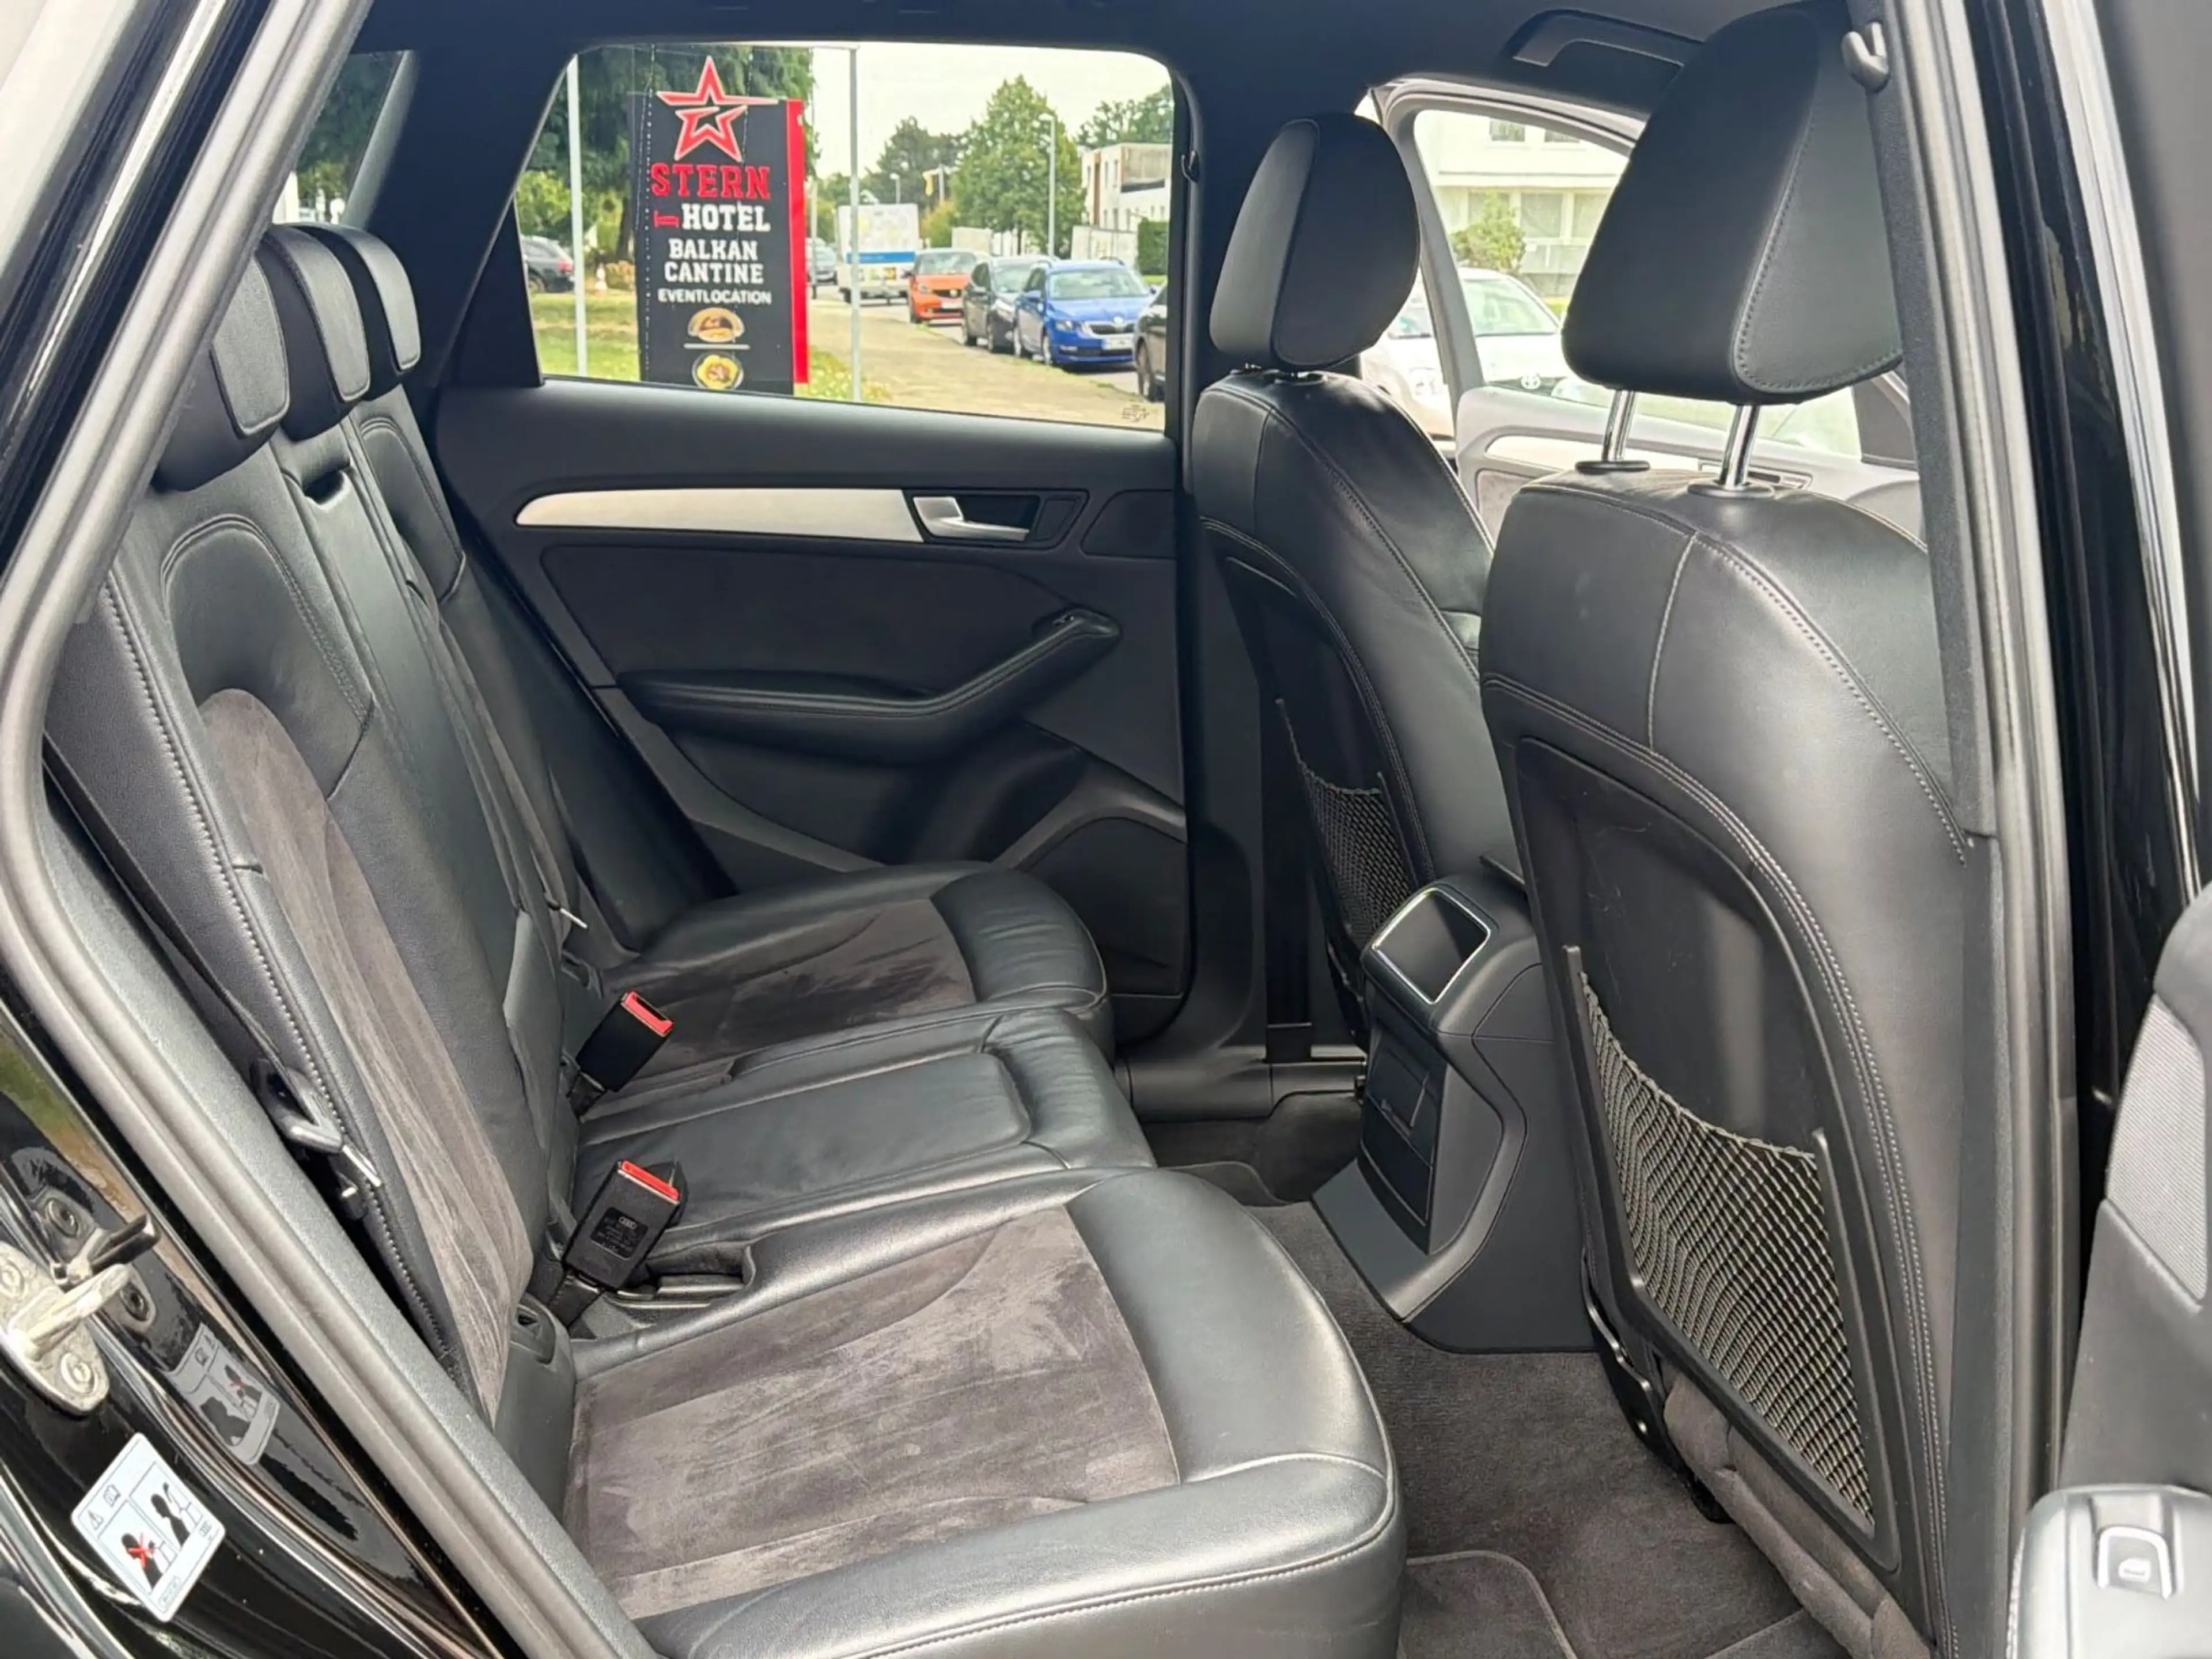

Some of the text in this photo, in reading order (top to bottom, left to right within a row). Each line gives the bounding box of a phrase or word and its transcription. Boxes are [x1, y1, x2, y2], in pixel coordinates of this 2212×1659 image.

[651, 162, 771, 199] STERN
[681, 203, 771, 231] HOTEL
[668, 238, 758, 261] BALKAN
[664, 261, 764, 284] CANTINE
[657, 288, 772, 305] EVENTLOCATION
